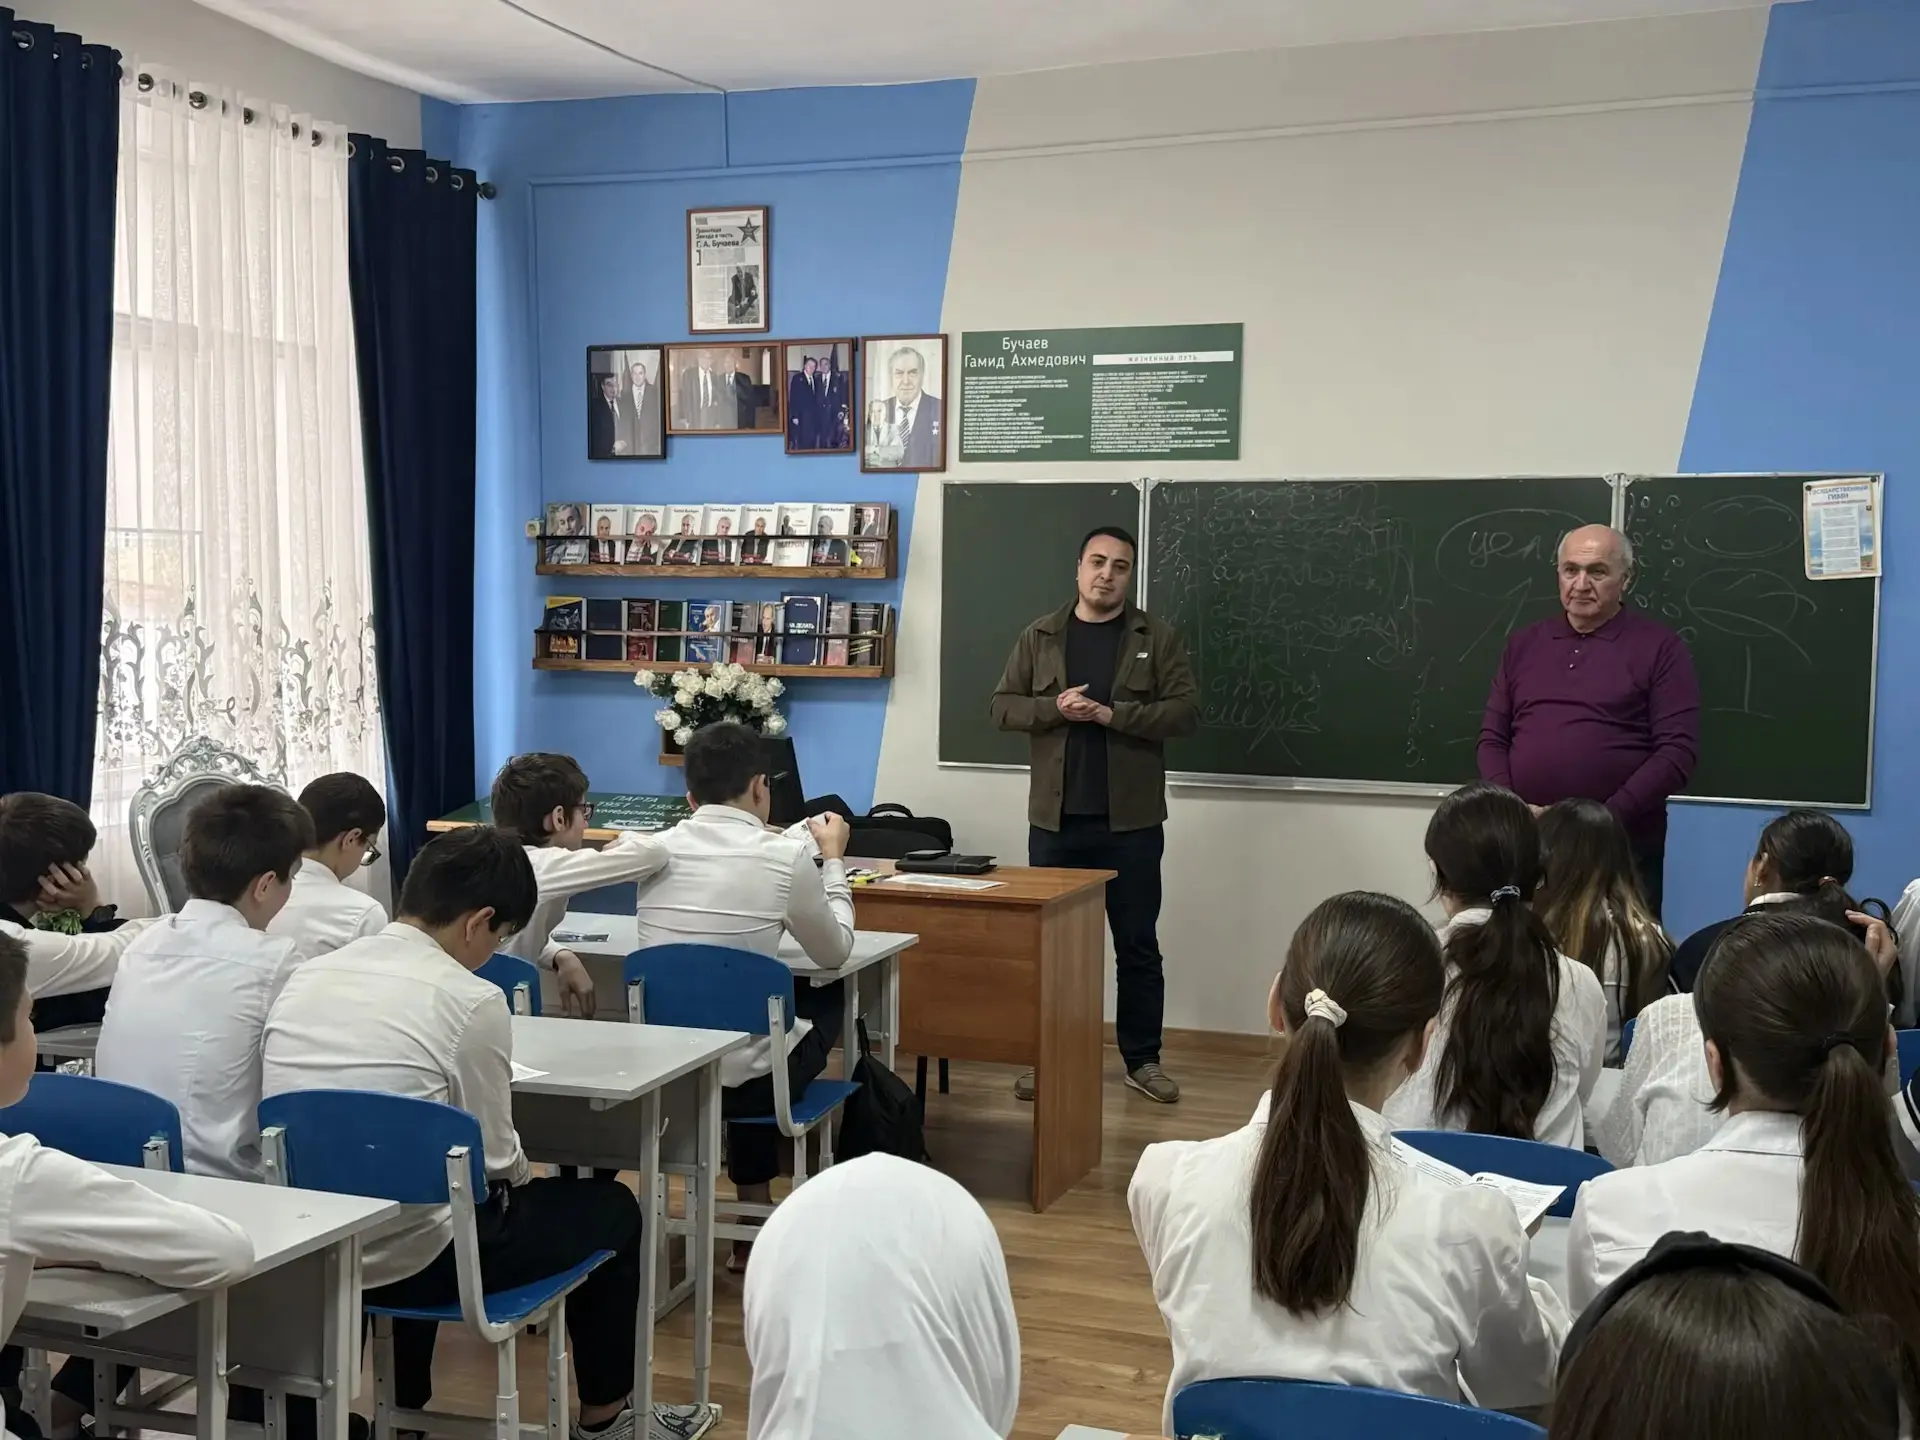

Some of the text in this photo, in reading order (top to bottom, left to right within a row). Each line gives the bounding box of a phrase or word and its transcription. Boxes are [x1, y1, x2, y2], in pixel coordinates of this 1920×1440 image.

[712, 239, 740, 248] Бучаева
[1002, 337, 1049, 353] Бучаев
[964, 353, 1087, 369] Гамид Ахмедович
[612, 795, 658, 803] ПАРТА
